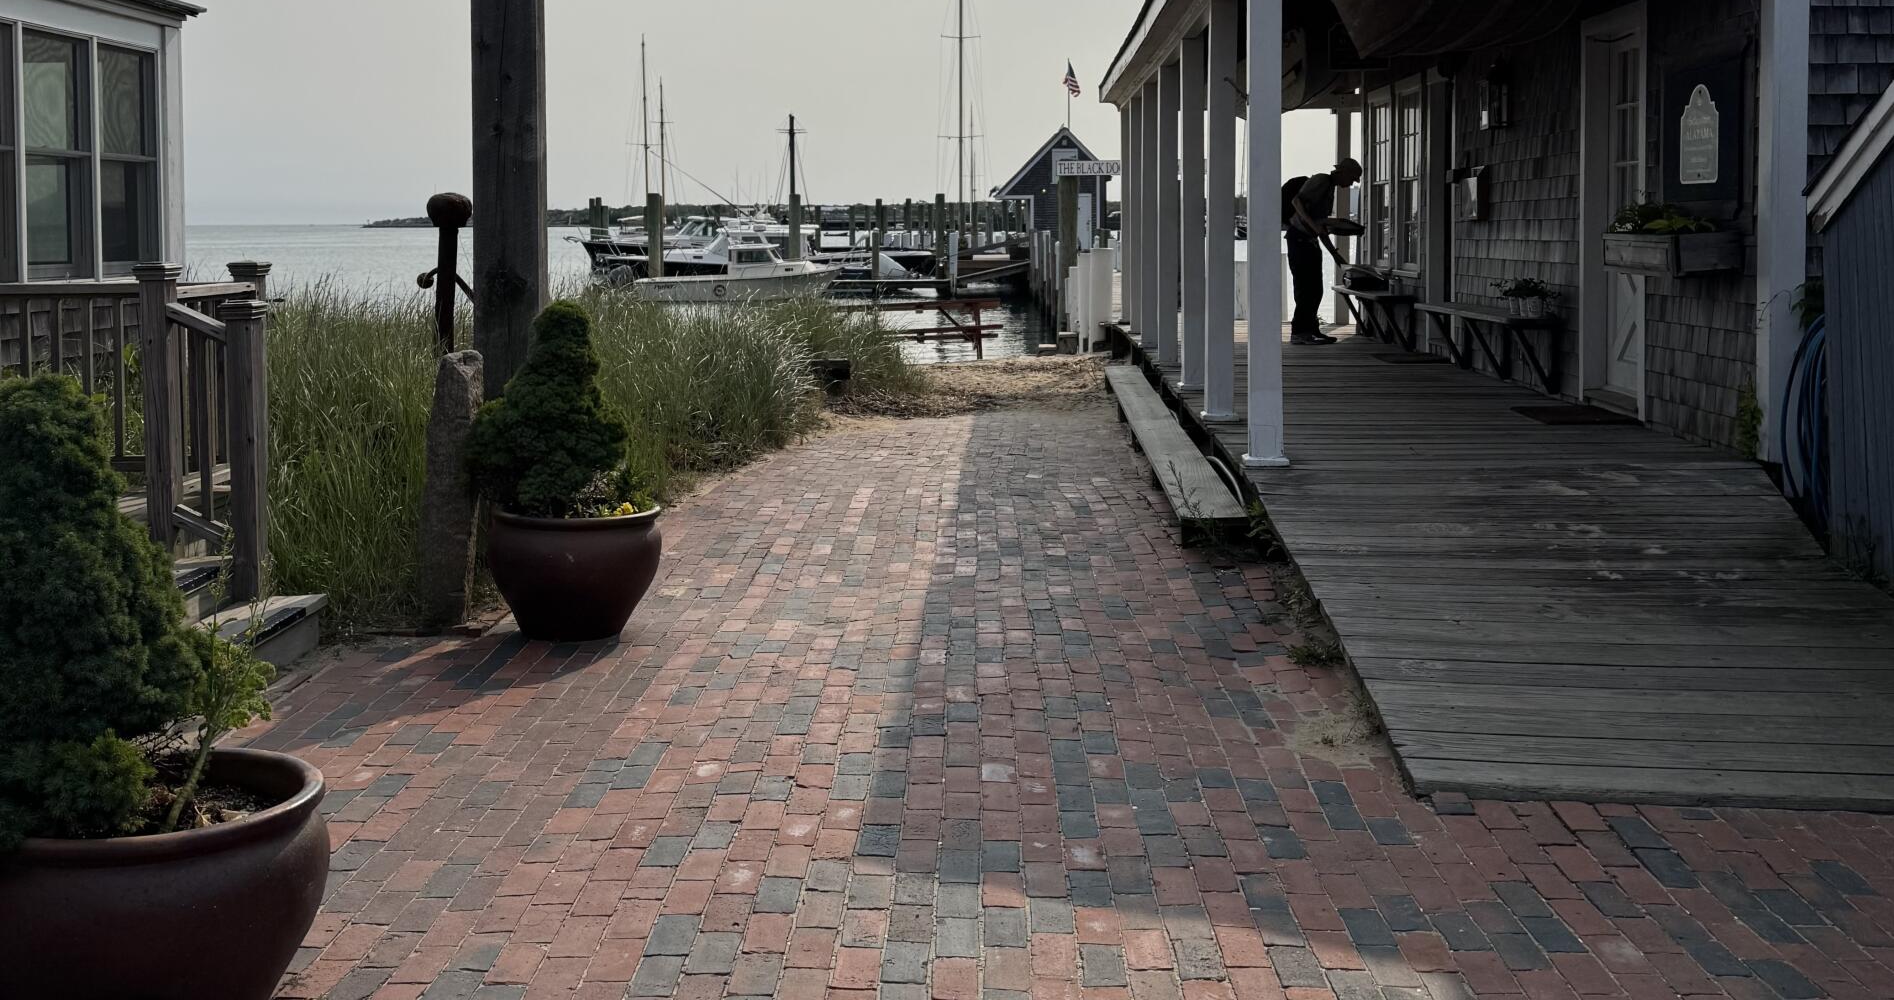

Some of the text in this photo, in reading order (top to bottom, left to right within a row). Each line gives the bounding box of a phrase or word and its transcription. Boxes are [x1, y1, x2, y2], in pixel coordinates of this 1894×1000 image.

[1058, 162, 1121, 174] THE BLACK DO
